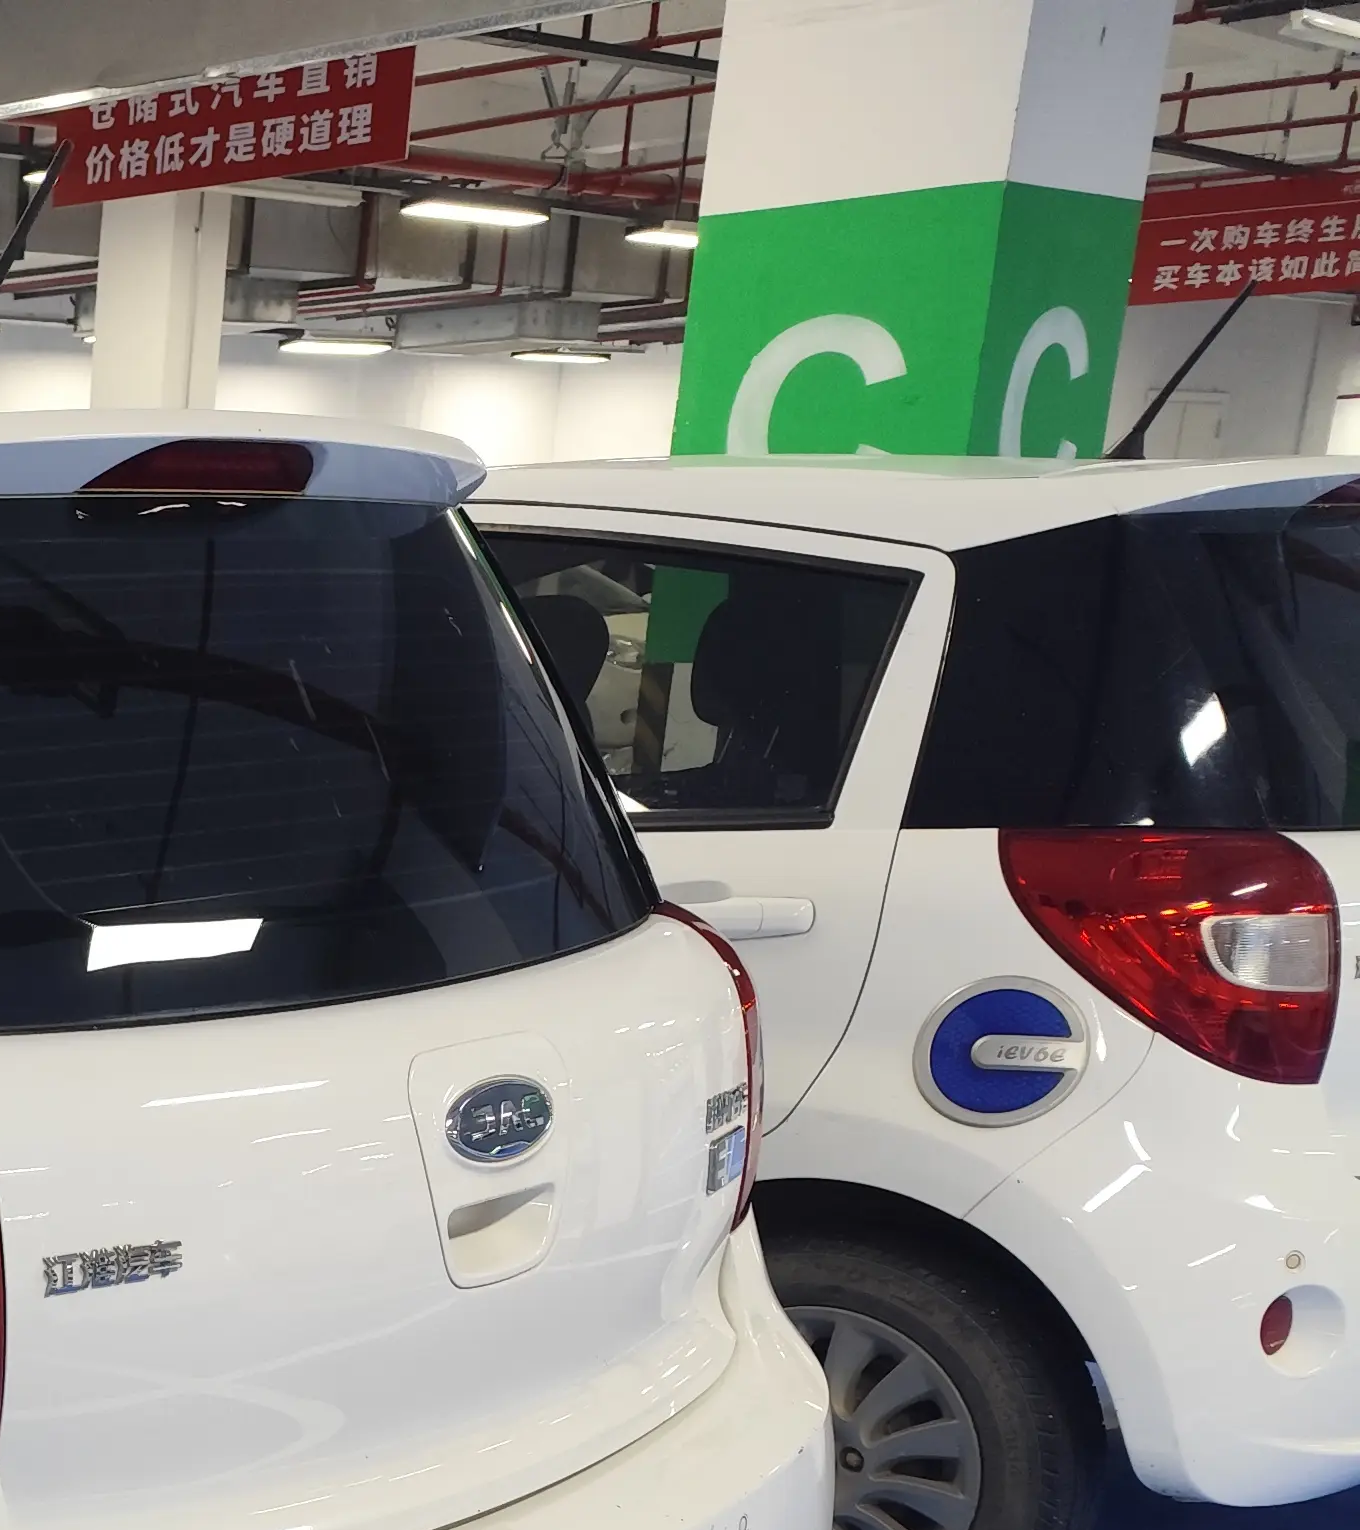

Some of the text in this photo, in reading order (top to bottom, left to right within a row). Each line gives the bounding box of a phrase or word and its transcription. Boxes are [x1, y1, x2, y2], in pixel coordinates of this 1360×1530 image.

[85, 102, 373, 185] 价格低才是硬道理
[42, 1239, 183, 1298] 江淮汽车
